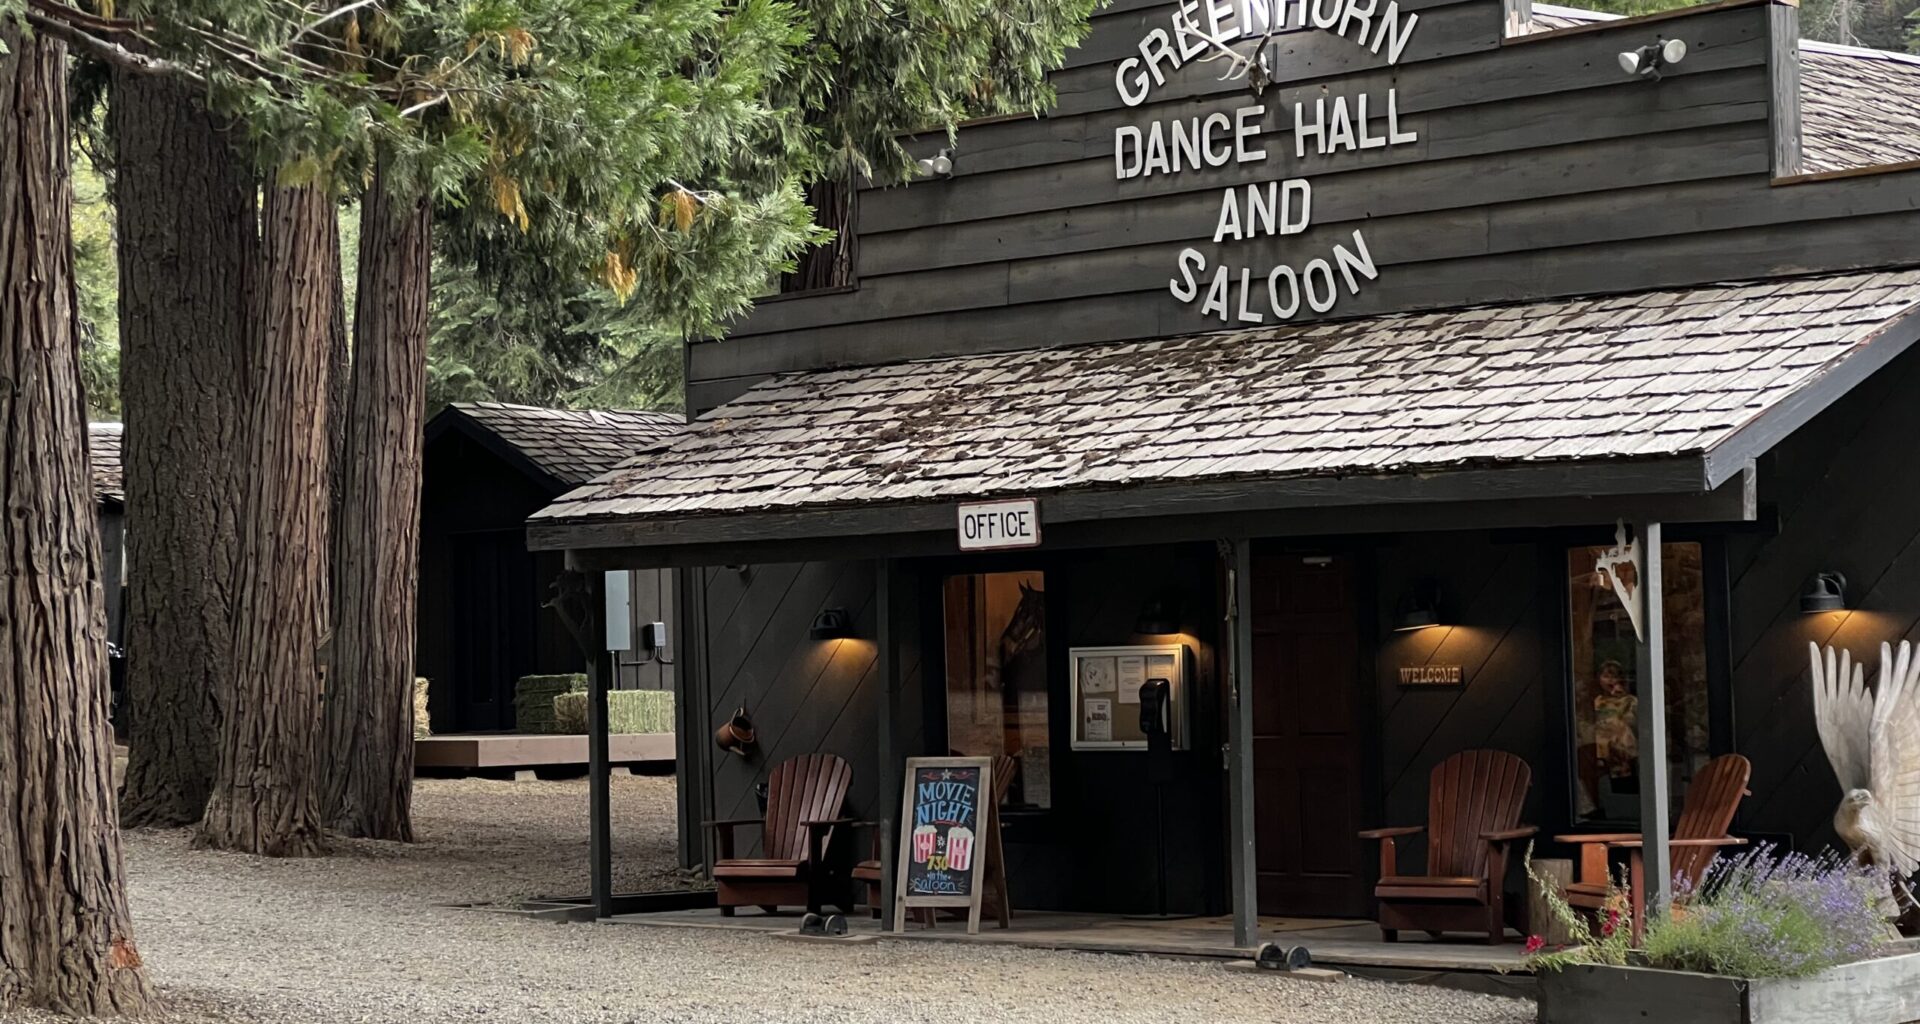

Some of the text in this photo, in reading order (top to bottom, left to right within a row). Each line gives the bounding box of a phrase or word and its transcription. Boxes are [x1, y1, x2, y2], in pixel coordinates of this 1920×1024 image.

[1115, 88, 1417, 180] DANCE HALL
[1213, 178, 1311, 243] AND
[1169, 229, 1378, 323] SALOON
[964, 511, 1031, 540] OFFICE
[1400, 666, 1460, 684] WELCOME
[919, 782, 975, 805] MOVIE
[917, 801, 973, 826] NIGHT
[927, 855, 948, 871] 730
[937, 870, 948, 880] the
